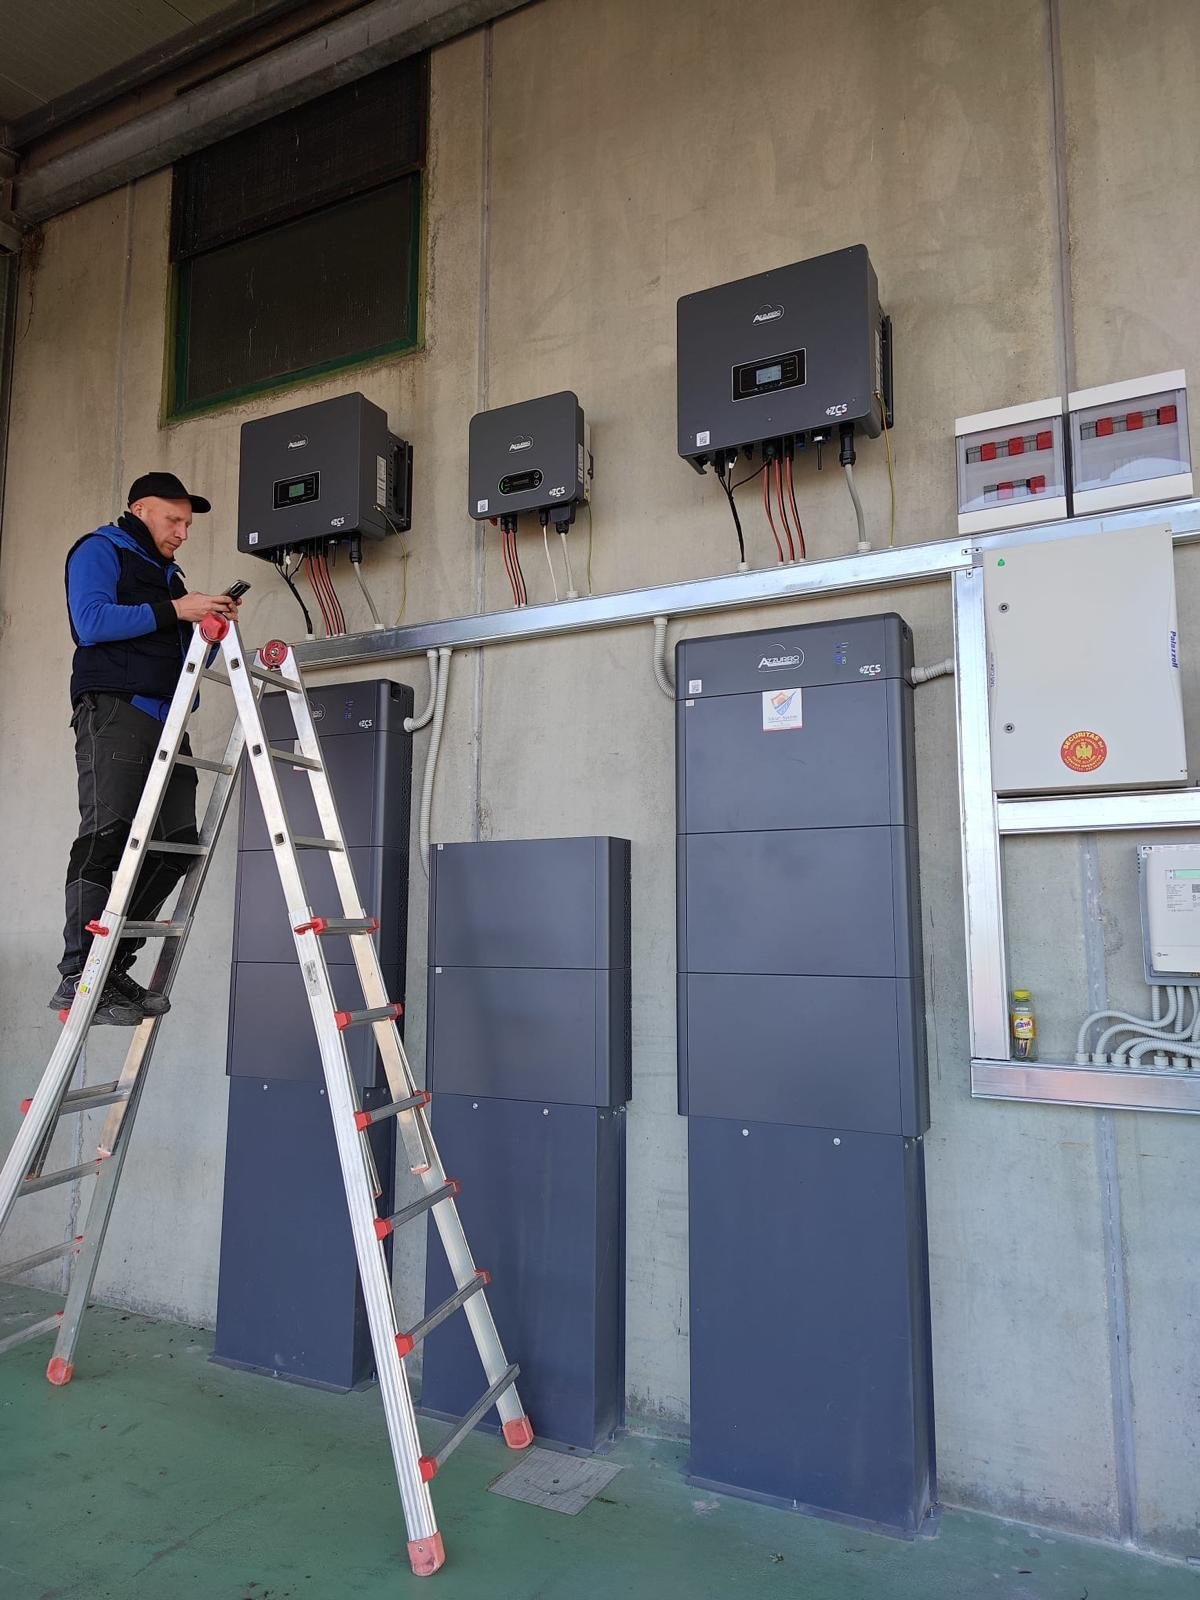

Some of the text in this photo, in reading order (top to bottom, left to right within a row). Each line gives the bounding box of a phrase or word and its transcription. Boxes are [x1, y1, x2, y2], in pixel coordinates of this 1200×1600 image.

[829, 403, 848, 415] ZCS
[863, 664, 881, 674] ZCS
[1063, 732, 1099, 749] SECURITAS
